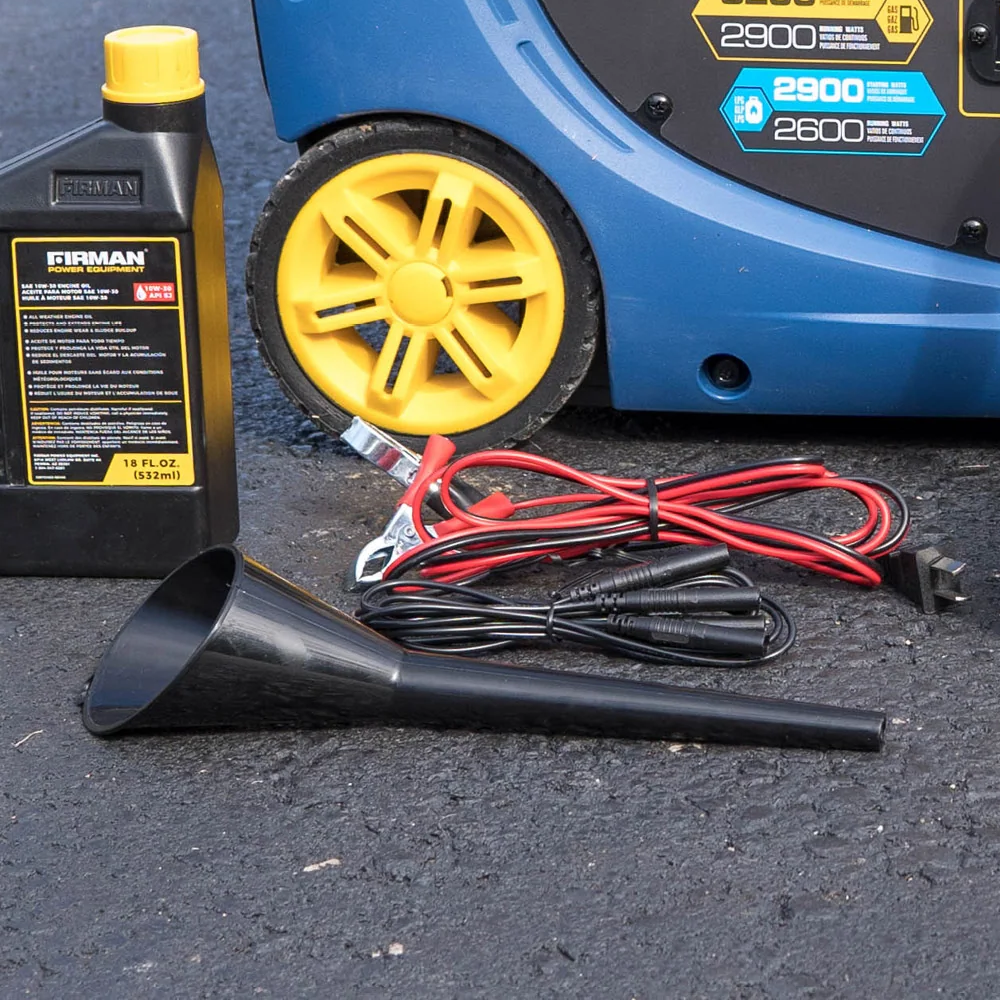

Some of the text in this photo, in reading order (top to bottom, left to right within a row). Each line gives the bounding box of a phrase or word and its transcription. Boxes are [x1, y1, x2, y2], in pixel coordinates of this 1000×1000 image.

[887, 5, 897, 13] GAS
[720, 22, 816, 49] 2900
[773, 76, 864, 103] 2900
[774, 117, 864, 142] 2600
[61, 180, 138, 197] FIRMAN
[47, 251, 145, 265] FIRMAN
[124, 459, 180, 467] 18 FL.OZ.
[134, 471, 180, 480] (532ml)
